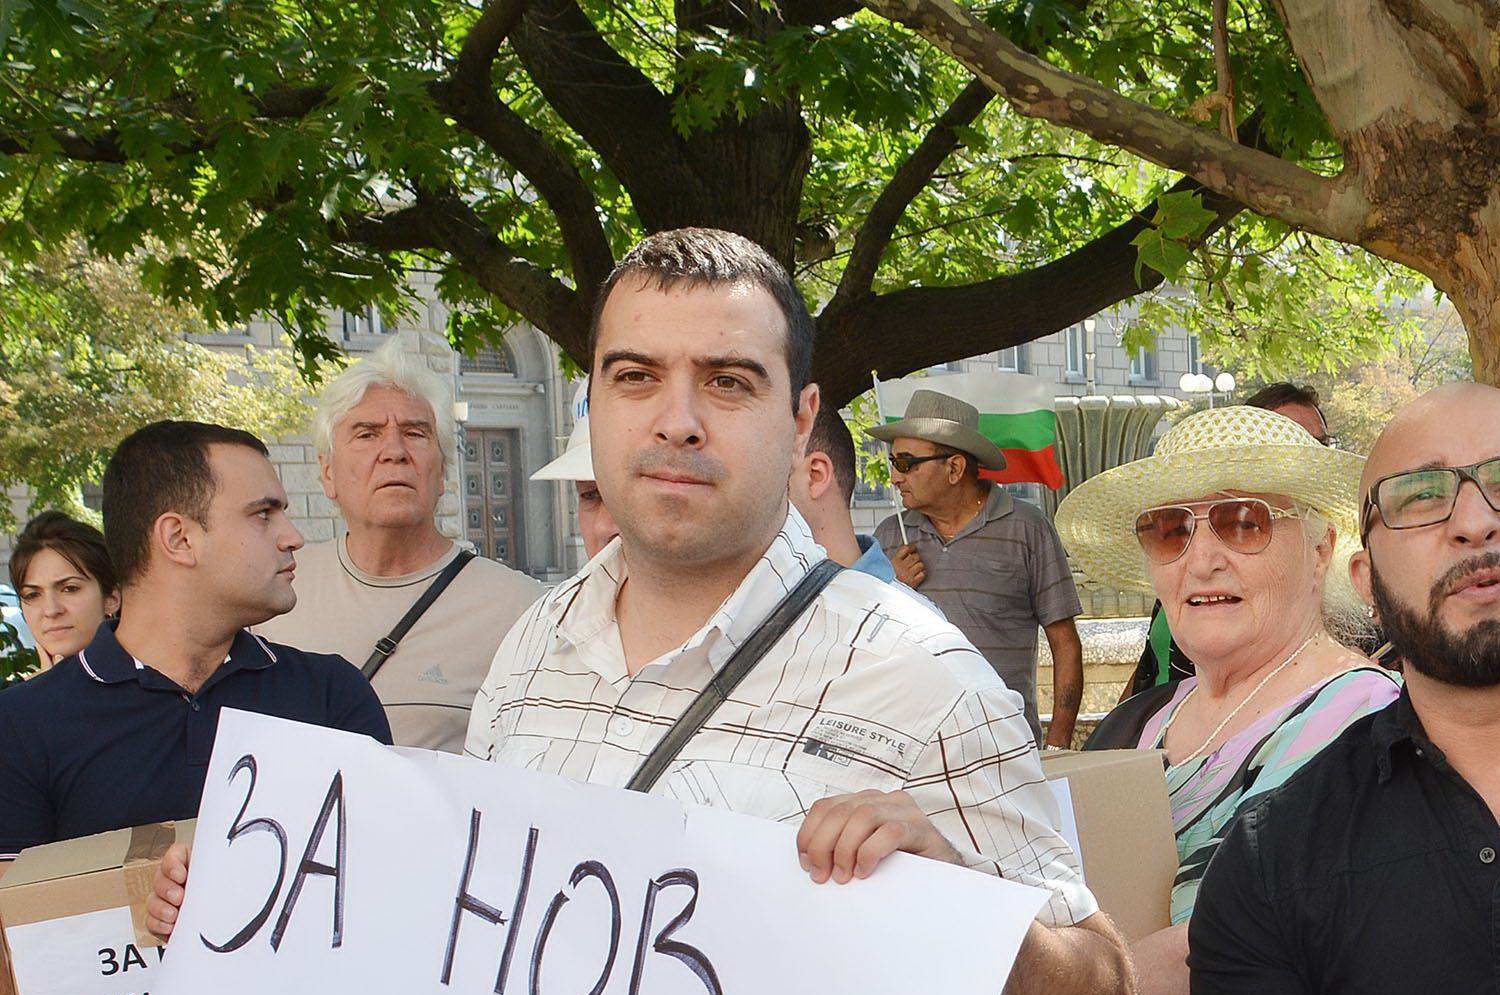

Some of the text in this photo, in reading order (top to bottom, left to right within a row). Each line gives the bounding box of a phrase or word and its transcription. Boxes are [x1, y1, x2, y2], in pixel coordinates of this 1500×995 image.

[820, 718, 867, 736] LEISURE
[869, 731, 906, 751] STYLE
[199, 755, 345, 953] ЗА
[98, 943, 147, 976] ЗА
